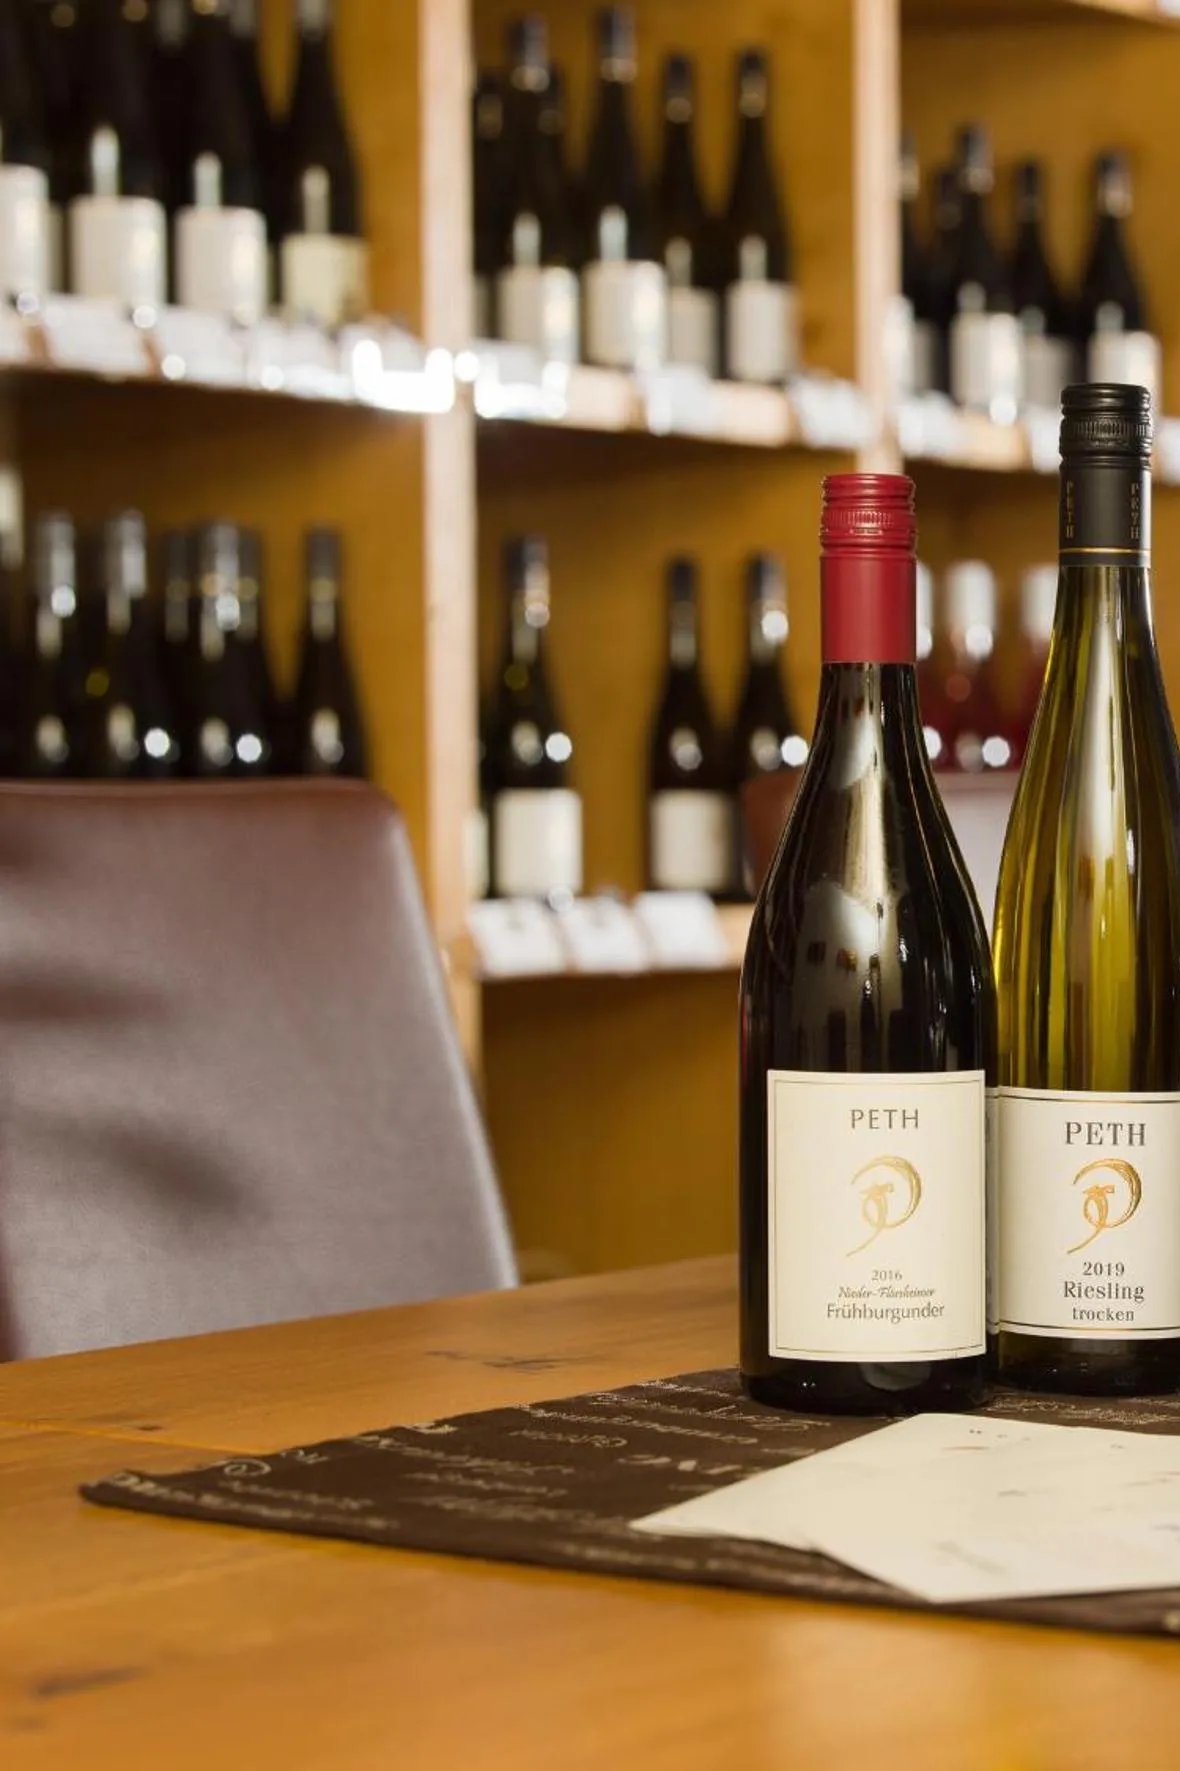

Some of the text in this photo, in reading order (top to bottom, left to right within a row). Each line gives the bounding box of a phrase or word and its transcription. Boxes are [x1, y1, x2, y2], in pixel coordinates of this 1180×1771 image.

[850, 1108, 920, 1130] PETH
[1064, 1121, 1147, 1147] PETH
[871, 1269, 903, 1282] 2016
[1082, 1261, 1126, 1277] 2019
[1063, 1280, 1145, 1302] Riesling
[827, 1302, 945, 1324] Frühburgunder
[1072, 1306, 1136, 1322] trocken
